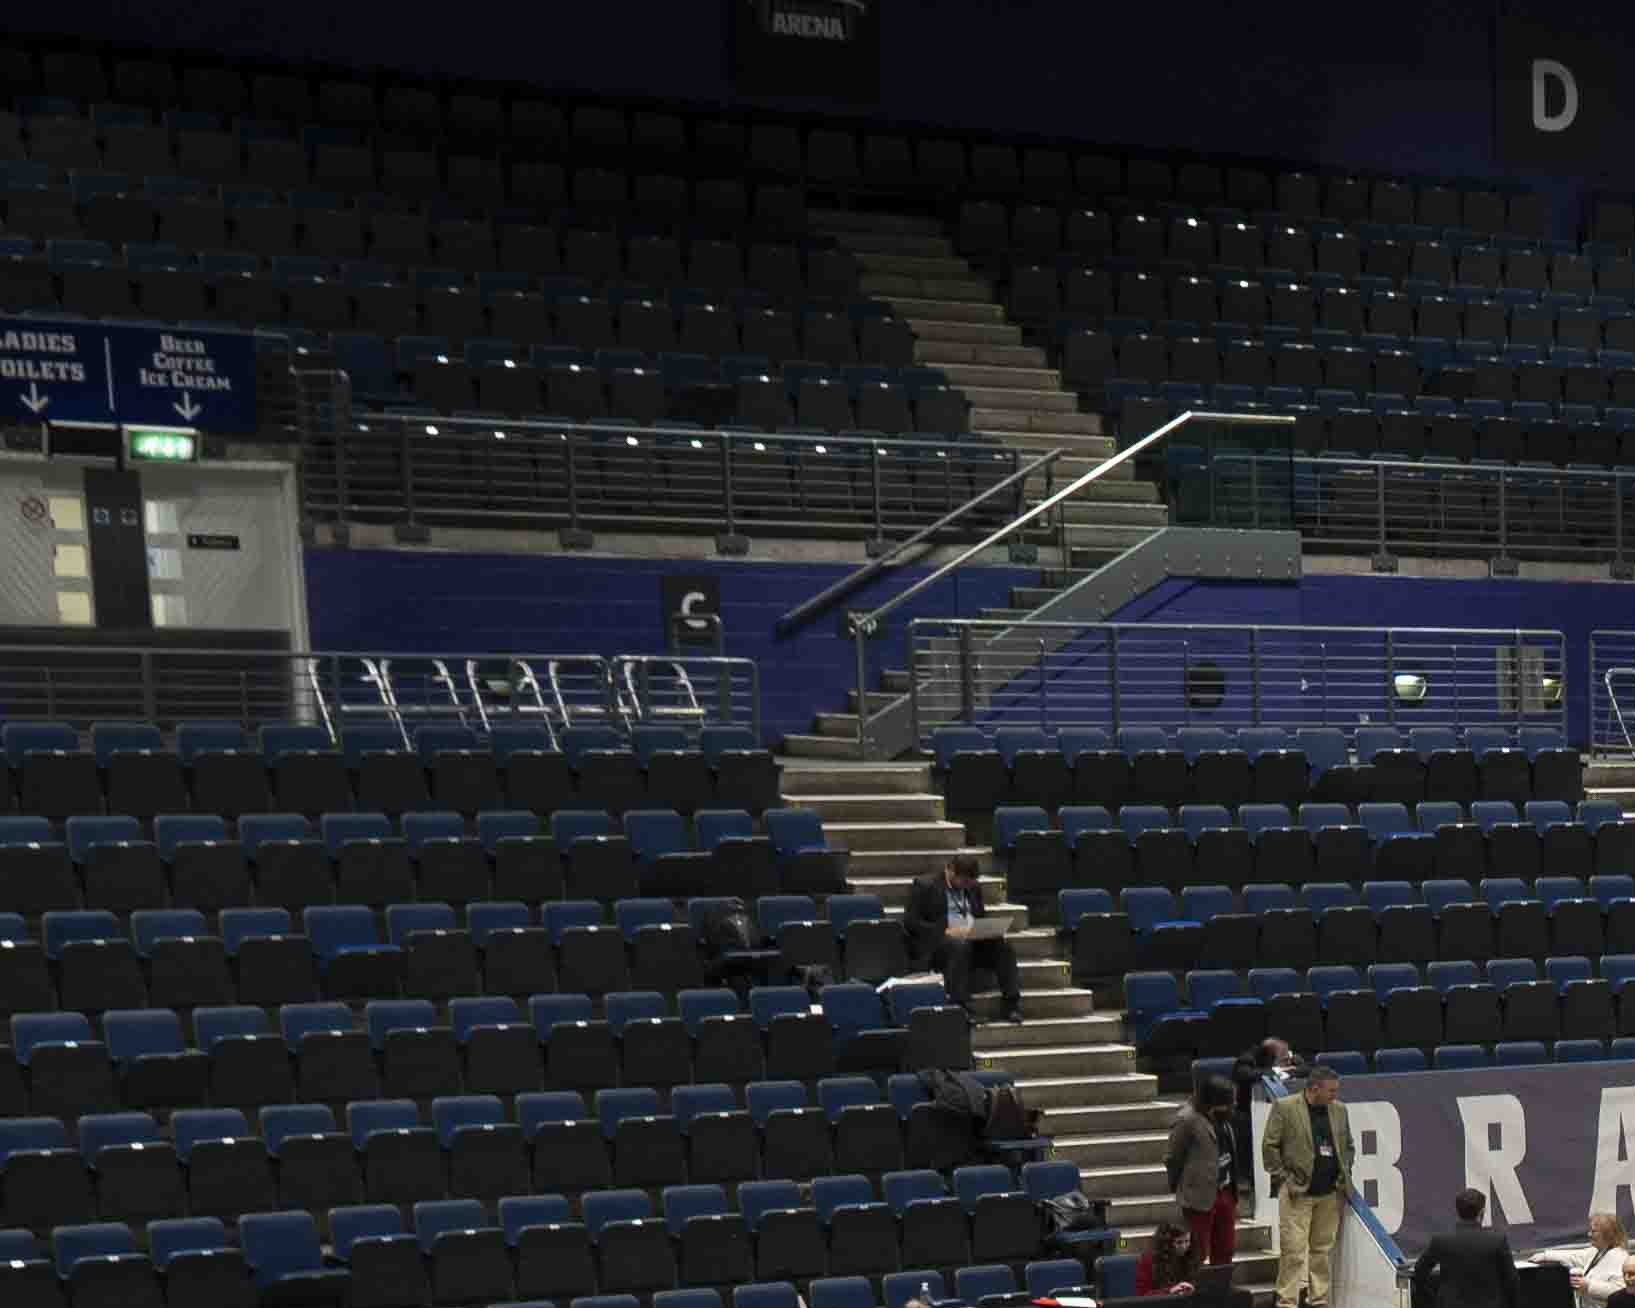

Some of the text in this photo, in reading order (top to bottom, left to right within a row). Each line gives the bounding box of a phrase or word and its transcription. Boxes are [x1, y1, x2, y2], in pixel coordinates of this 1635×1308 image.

[773, 12, 848, 41] ARENA
[1532, 58, 1578, 133] D
[0, 358, 86, 383] OILETS
[140, 369, 232, 393] ICE CREAM
[681, 592, 707, 631] C
